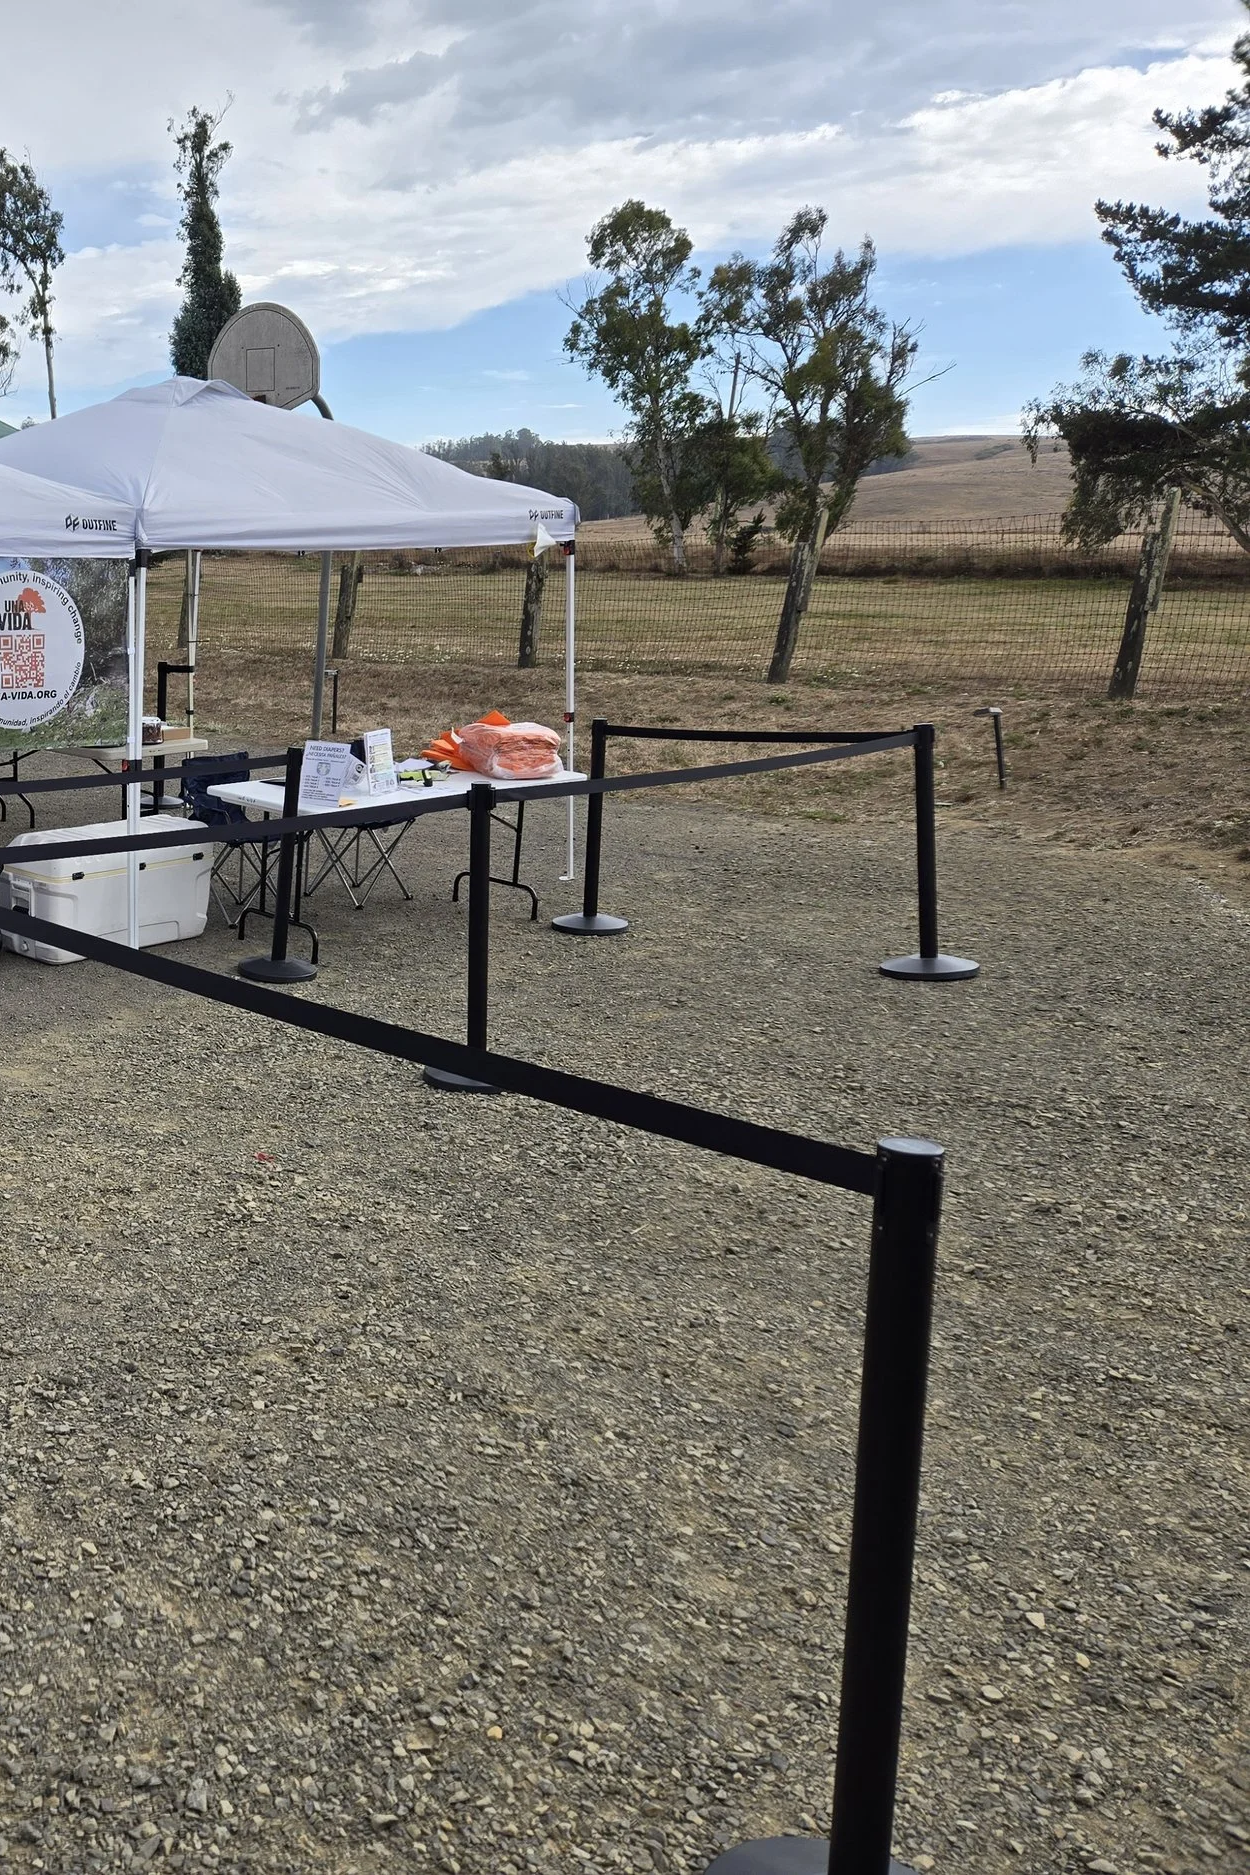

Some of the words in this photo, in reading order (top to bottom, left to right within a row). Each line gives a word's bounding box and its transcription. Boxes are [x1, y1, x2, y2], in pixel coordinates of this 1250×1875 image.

[540, 510, 564, 520] OUTFINE
[82, 518, 117, 531] OUTFINE
[4, 600, 25, 612] UNA
[32, 573, 69, 606] inspiring
[67, 604, 83, 644] change
[29, 699, 64, 725] inspirando
[63, 689, 70, 699] el
[68, 661, 82, 691] cambio
